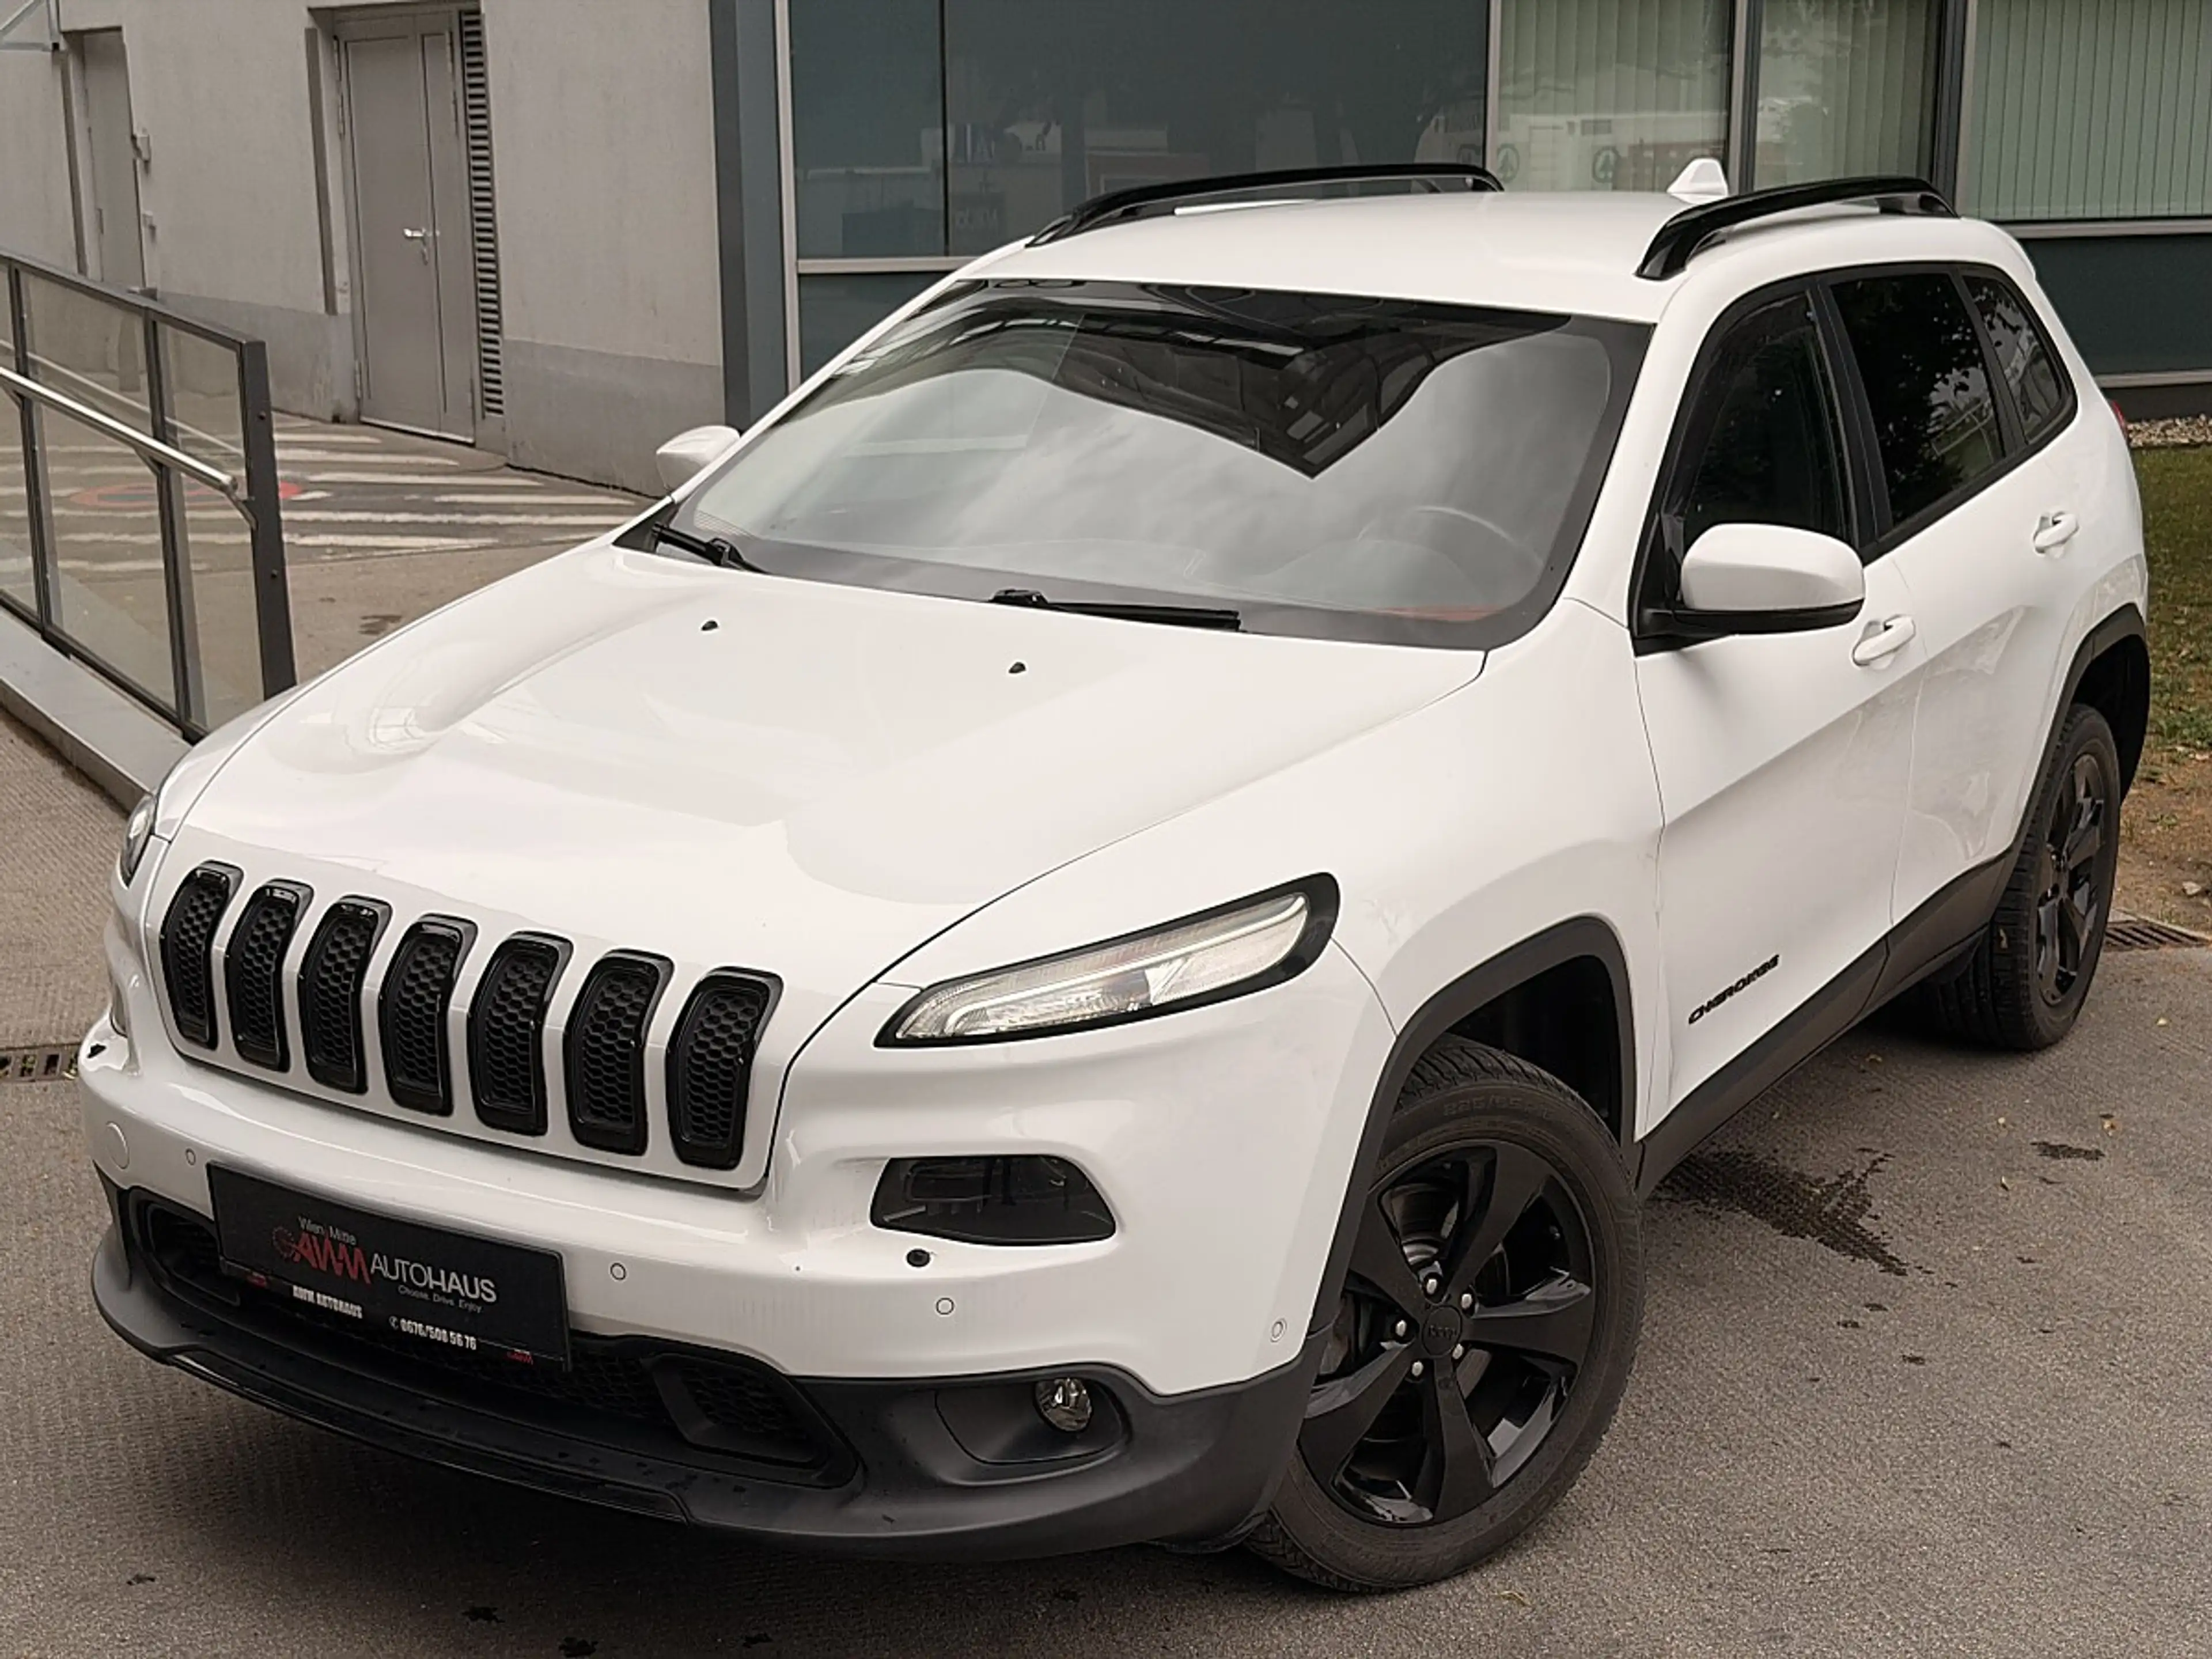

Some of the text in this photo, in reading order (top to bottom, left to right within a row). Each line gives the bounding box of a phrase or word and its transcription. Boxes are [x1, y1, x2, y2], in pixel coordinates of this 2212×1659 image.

[1688, 954, 1779, 1025] CHEROKEE
[370, 1253, 497, 1303] AUTOHAUS
[316, 1291, 363, 1319] AUTOHAUS
[464, 1334, 477, 1350] 76
